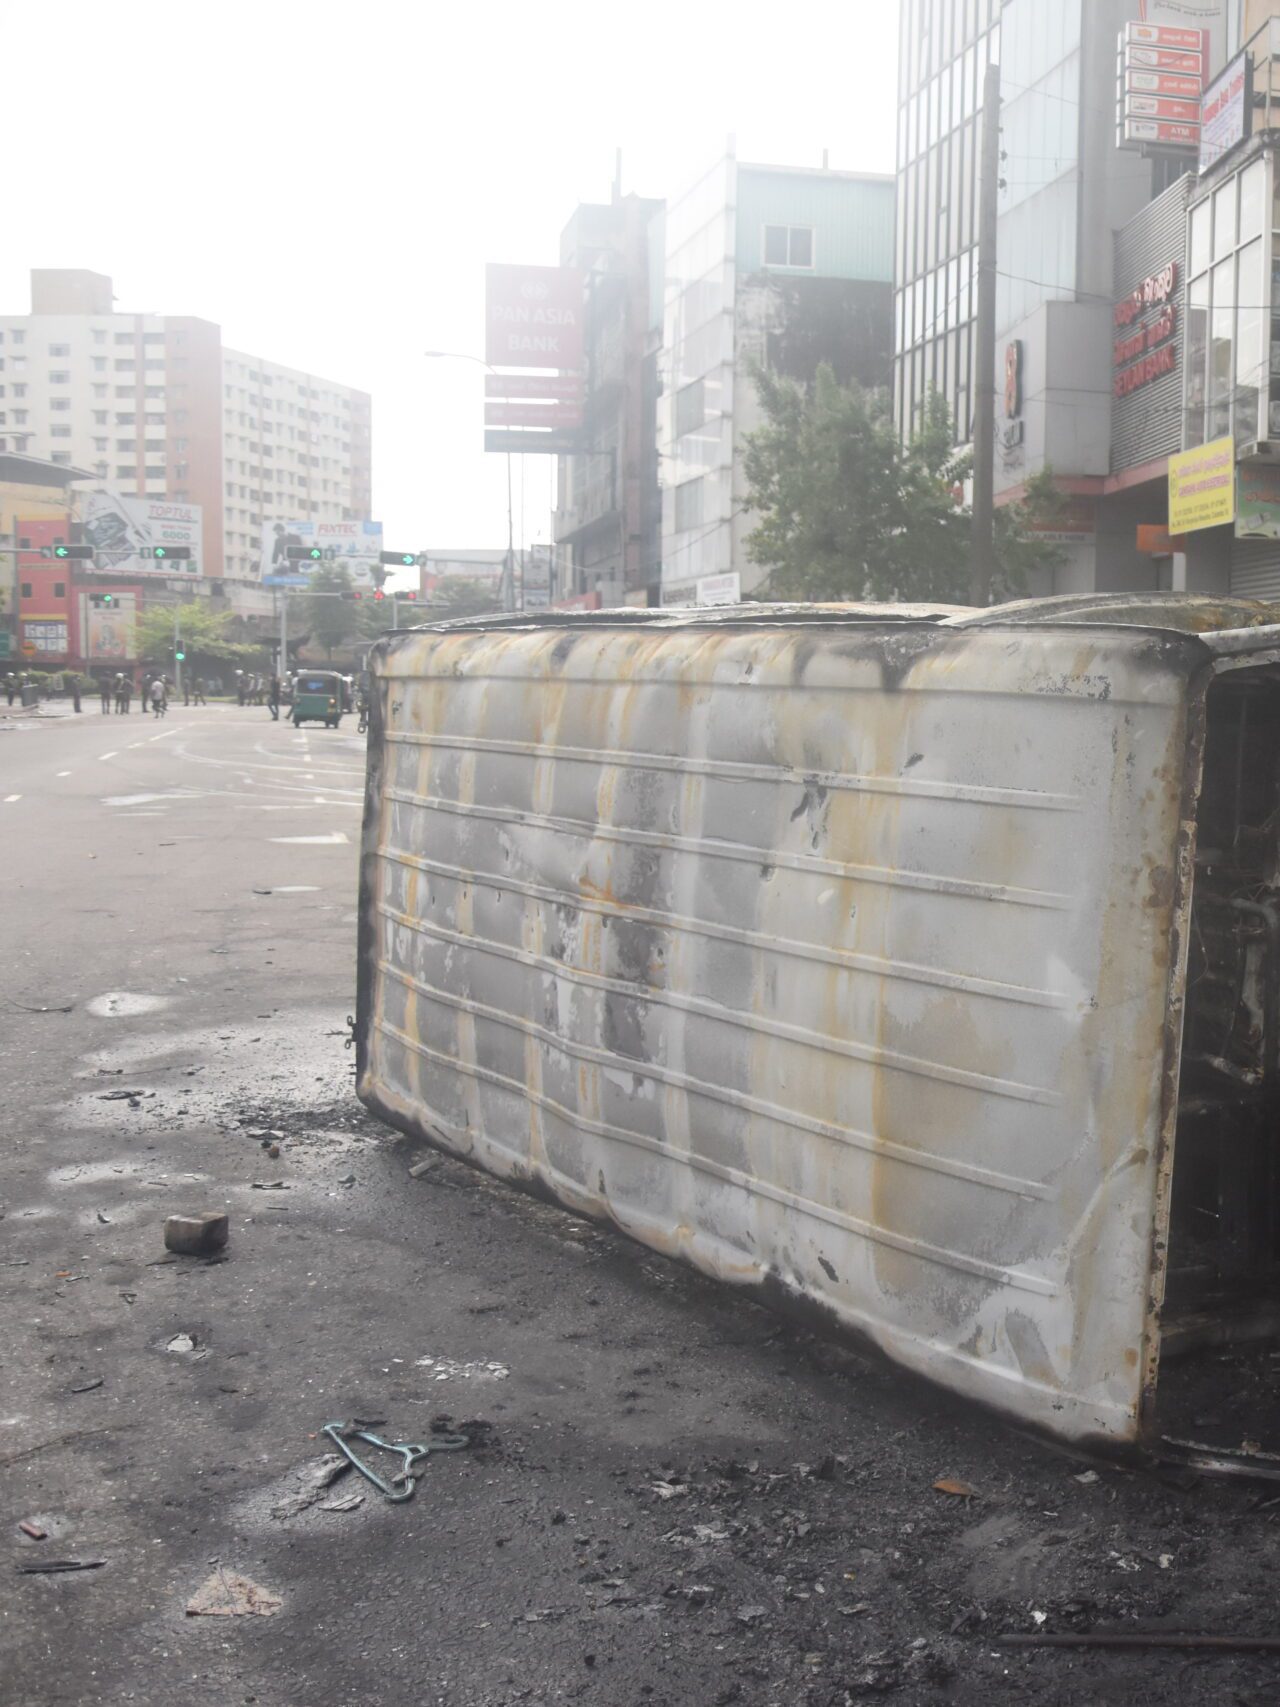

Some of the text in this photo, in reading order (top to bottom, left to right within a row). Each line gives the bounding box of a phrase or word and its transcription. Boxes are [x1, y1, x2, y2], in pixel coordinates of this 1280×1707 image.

[493, 305, 576, 326] PAN ASIA
[508, 335, 560, 352] BANK
